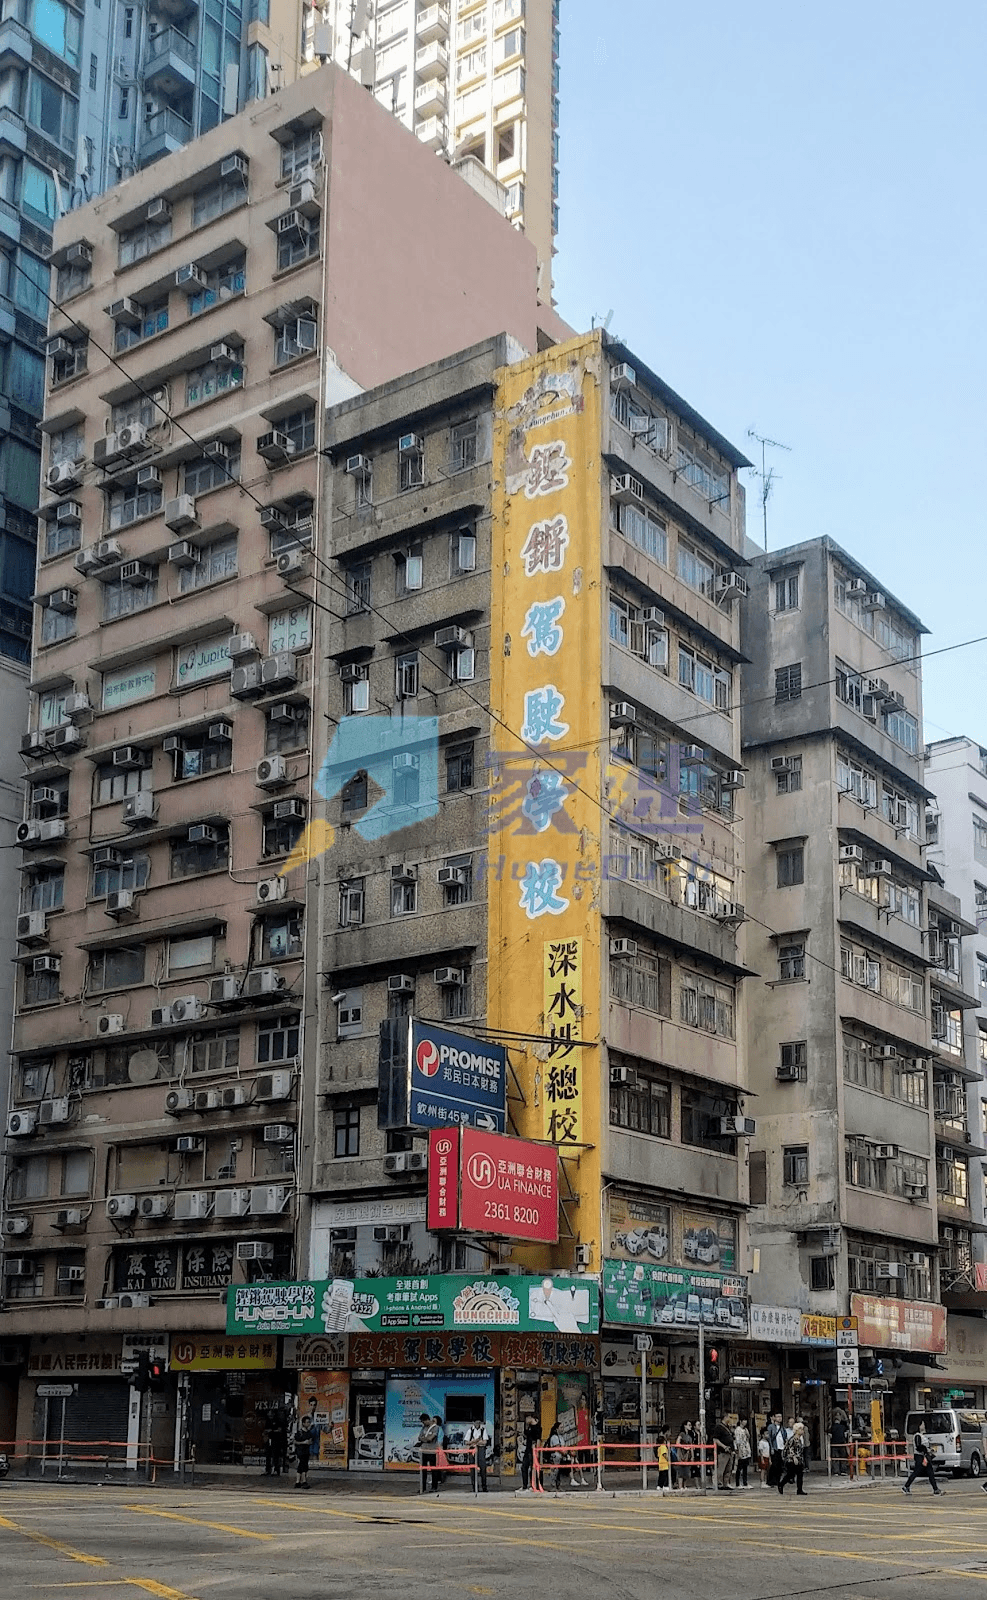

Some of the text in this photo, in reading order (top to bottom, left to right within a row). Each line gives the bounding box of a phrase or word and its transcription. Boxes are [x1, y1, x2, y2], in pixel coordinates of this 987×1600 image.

[272, 630, 308, 653] 8335
[546, 940, 579, 1142] 深水埗總校
[440, 1045, 500, 1078] PROMISE
[443, 1067, 498, 1094] 邦民日本財務
[498, 1159, 552, 1182] 亞洲聯合財務
[438, 1156, 447, 1216] 亞洲聯合財務
[498, 1176, 552, 1199] UA FINANCE
[484, 1201, 539, 1225] 2361 8200
[127, 1278, 145, 1290] KAI
[151, 1276, 176, 1288] WING
[419, 1293, 438, 1303] Apps
[235, 1305, 315, 1321] HUNGCHUN
[387, 1318, 396, 1326] App
[454, 1311, 519, 1320] HUNGCHUN
[200, 1344, 272, 1360] 亞洲聯合財務
[296, 1353, 345, 1362] HUNGCHUN
[353, 1335, 494, 1364] 鏗鏘駕駛學校
